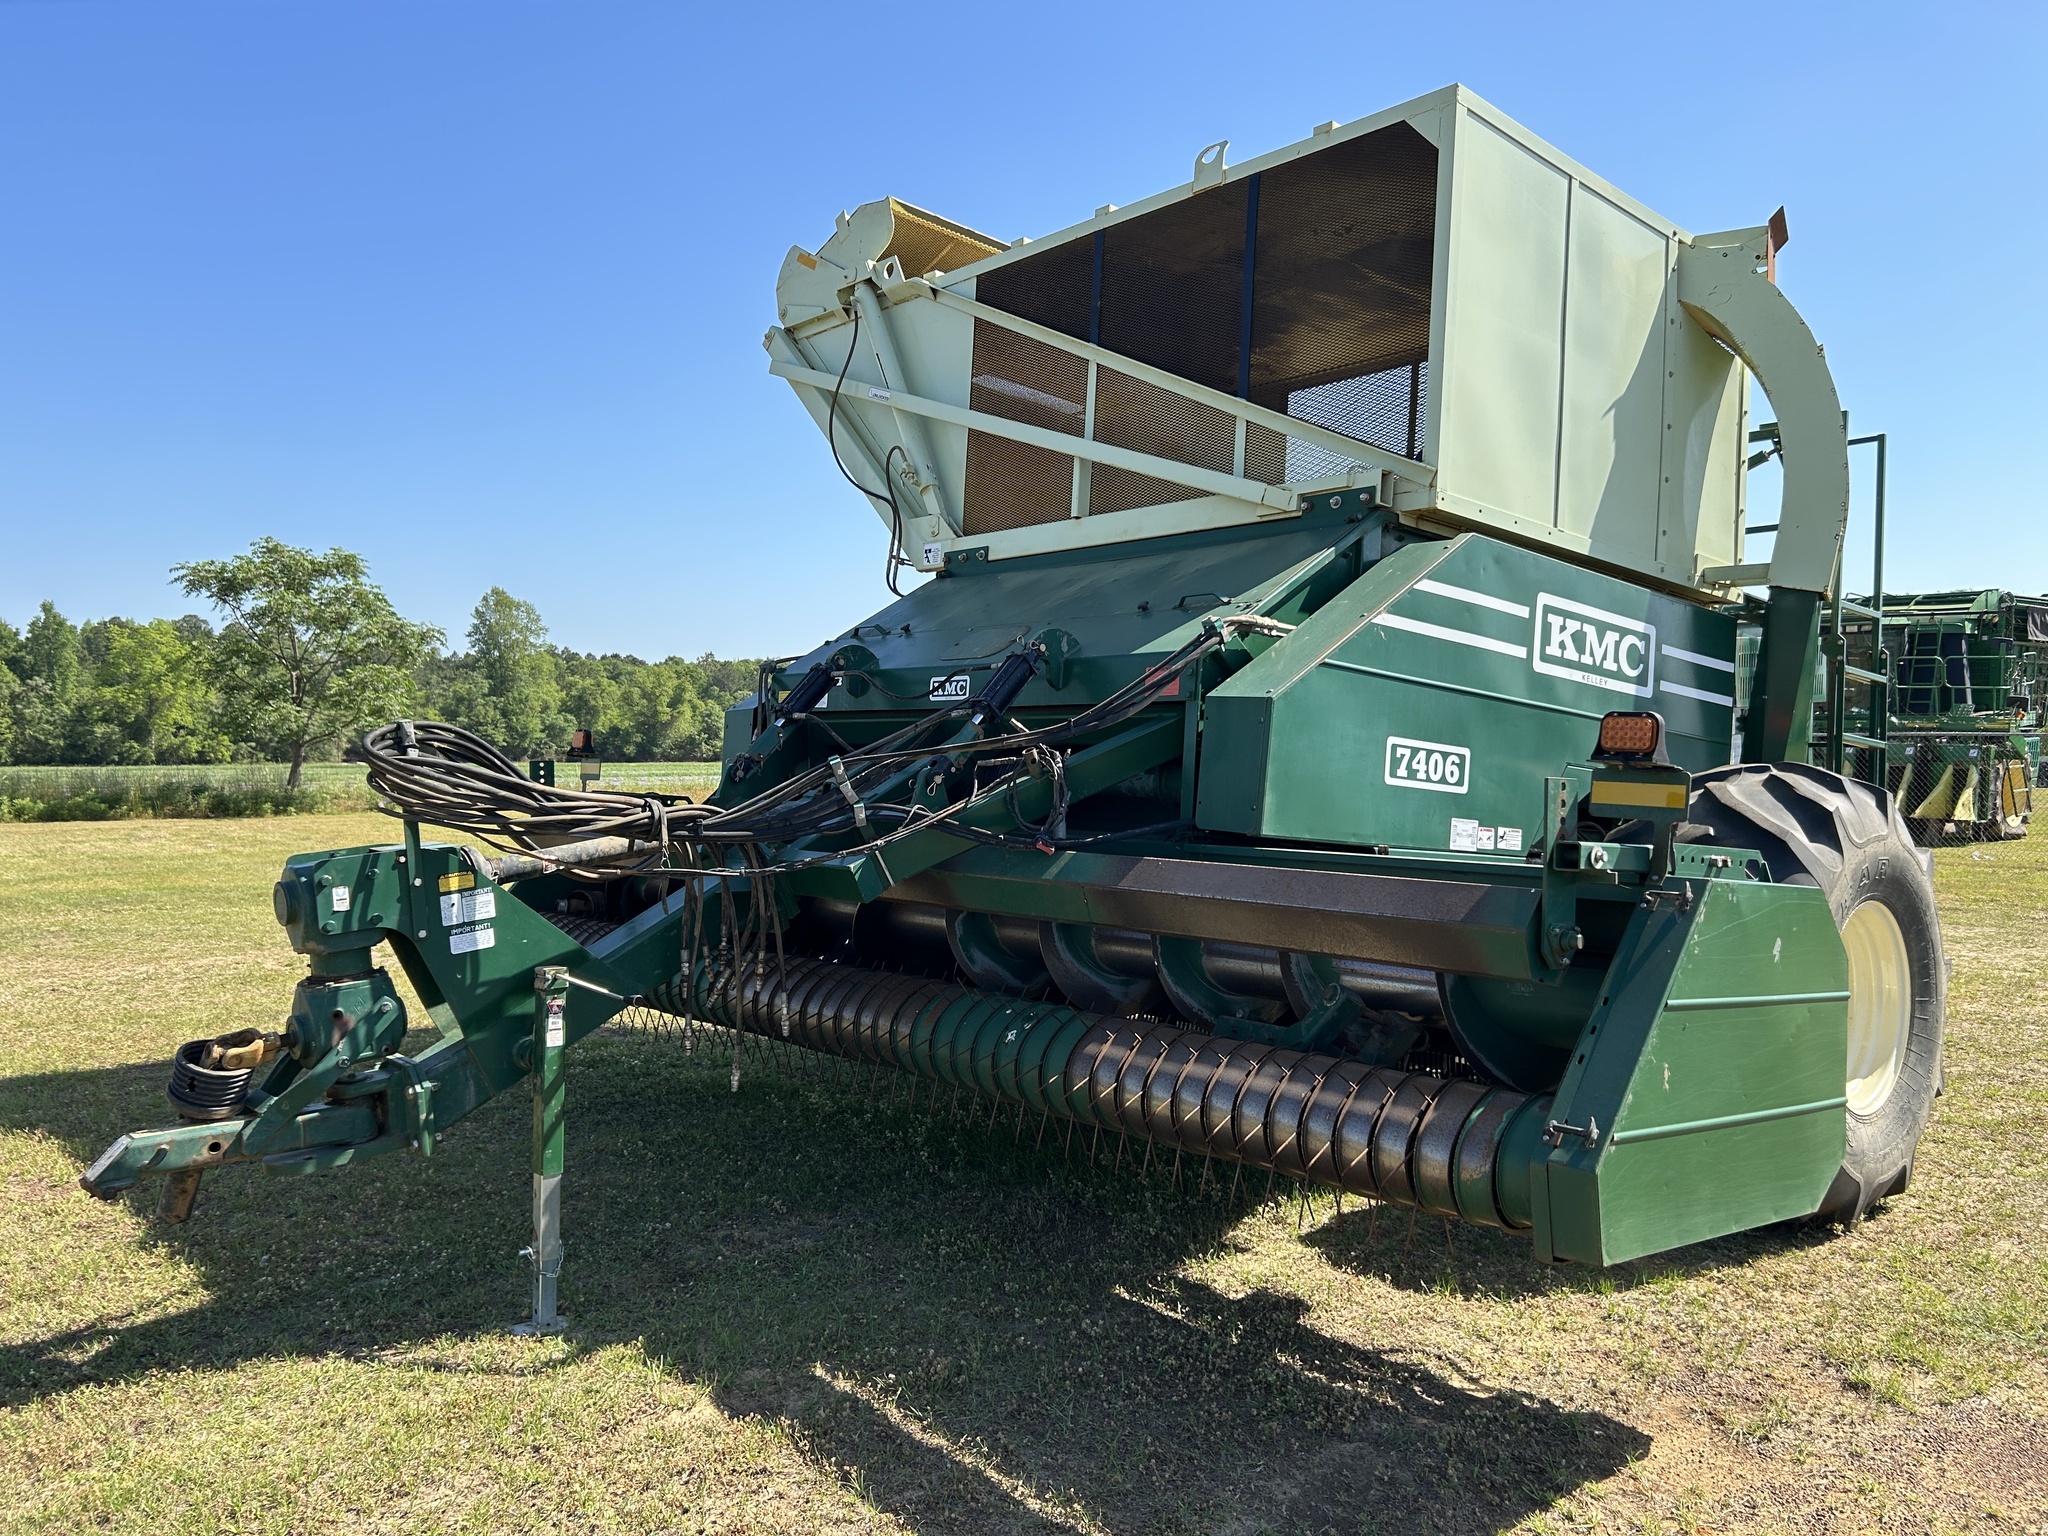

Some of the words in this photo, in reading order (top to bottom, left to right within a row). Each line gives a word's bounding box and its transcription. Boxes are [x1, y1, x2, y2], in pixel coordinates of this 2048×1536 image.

[1545, 612, 1645, 678] KMC
[1581, 673, 1608, 687] KELLEY
[1396, 746, 1460, 784] 7406
[451, 923, 491, 935] IMPORTANT!
